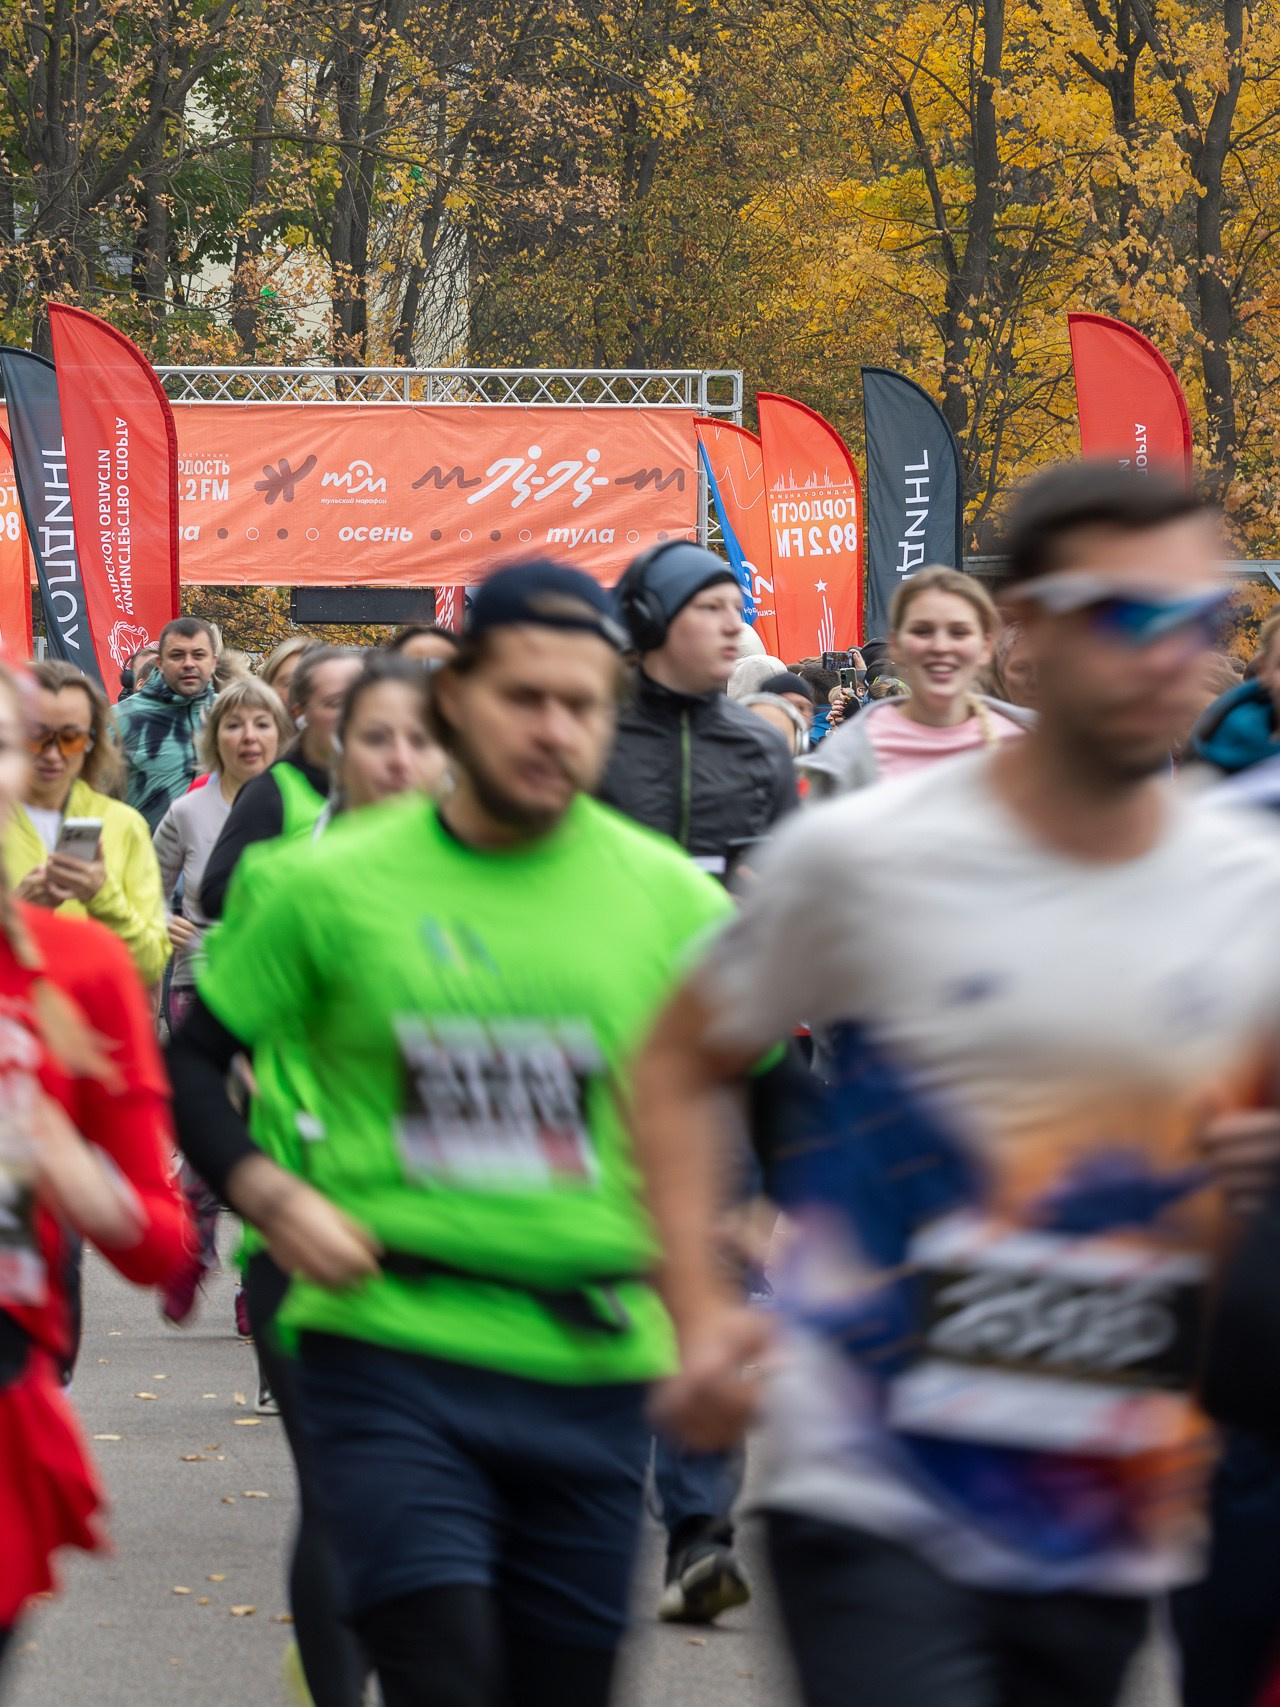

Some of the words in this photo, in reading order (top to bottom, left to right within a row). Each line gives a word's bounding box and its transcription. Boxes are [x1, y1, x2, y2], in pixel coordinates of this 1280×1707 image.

[178, 459, 230, 475] РДОСТЬ
[201, 478, 229, 501] FM
[338, 525, 414, 542] осень
[545, 527, 616, 549] тула
